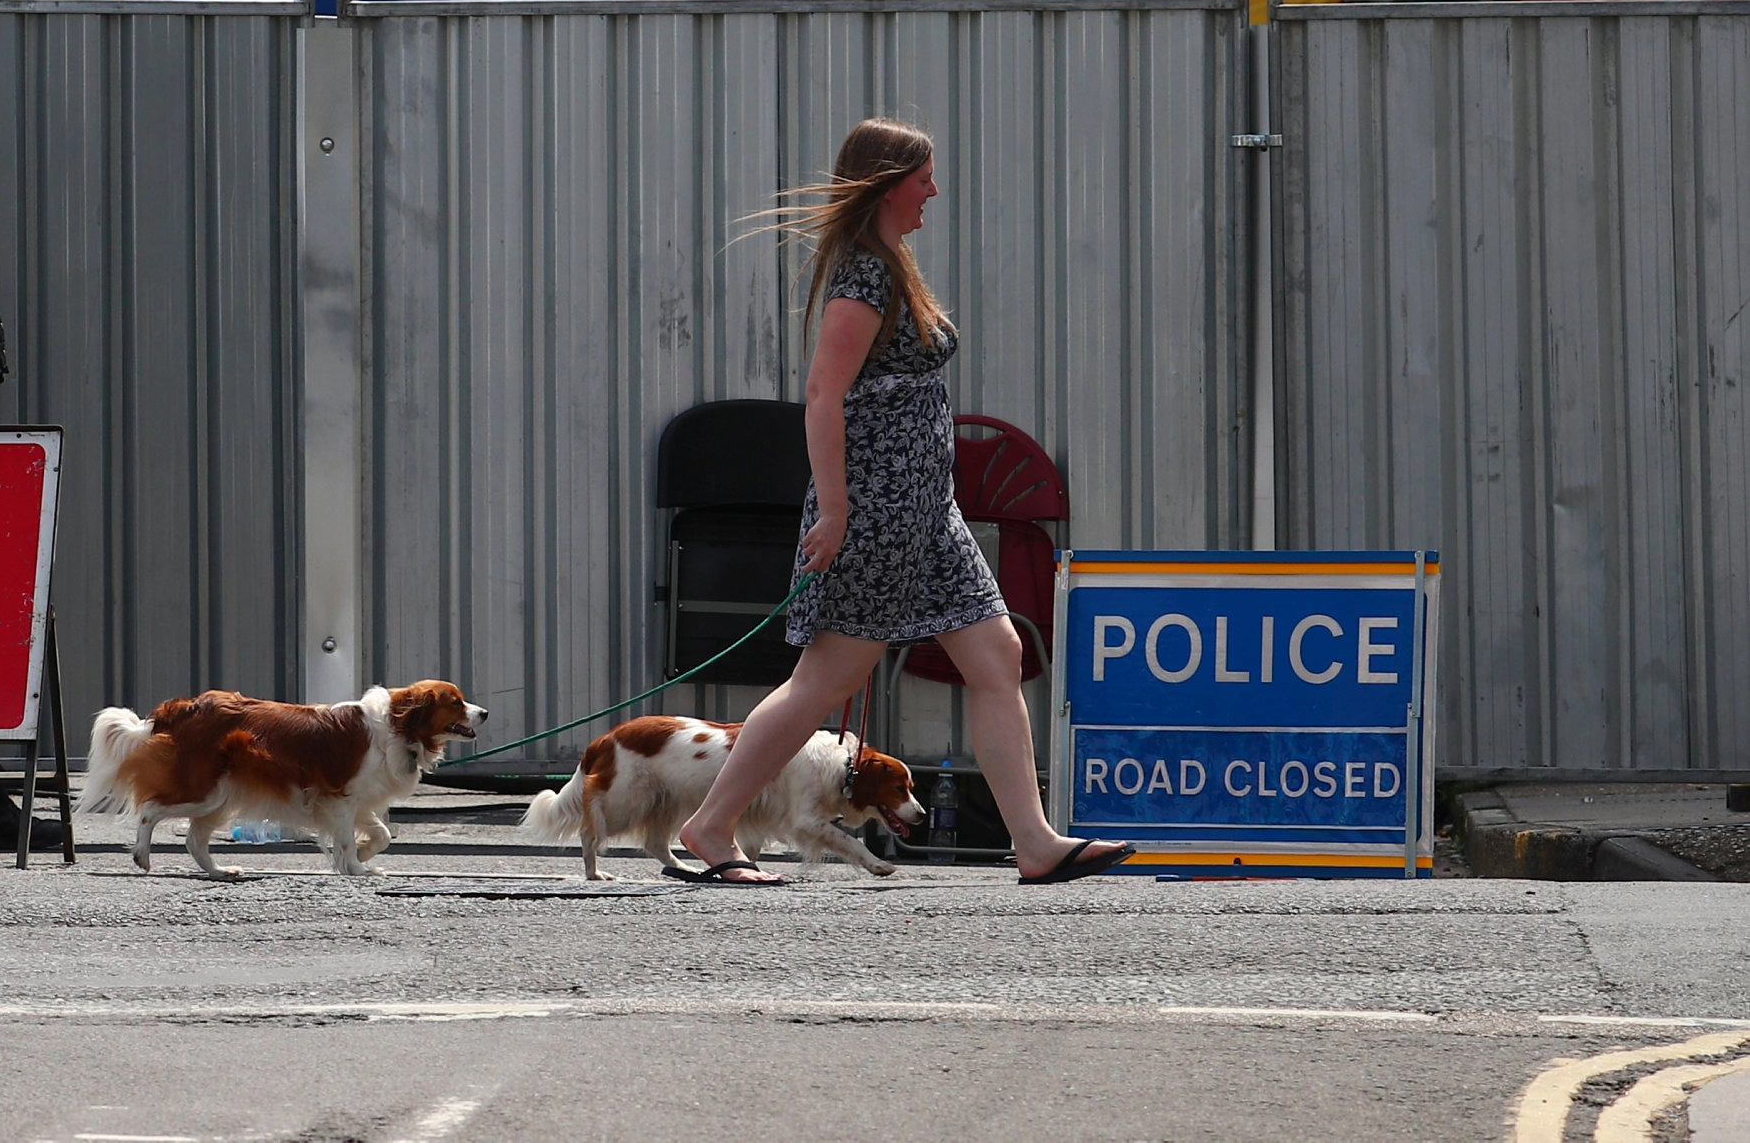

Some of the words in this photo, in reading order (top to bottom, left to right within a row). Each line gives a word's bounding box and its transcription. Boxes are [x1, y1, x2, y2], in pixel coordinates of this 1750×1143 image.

[1092, 613, 1399, 684] POLICE
[1085, 758, 1207, 796] ROAD
[1224, 759, 1401, 798] CLOSED
